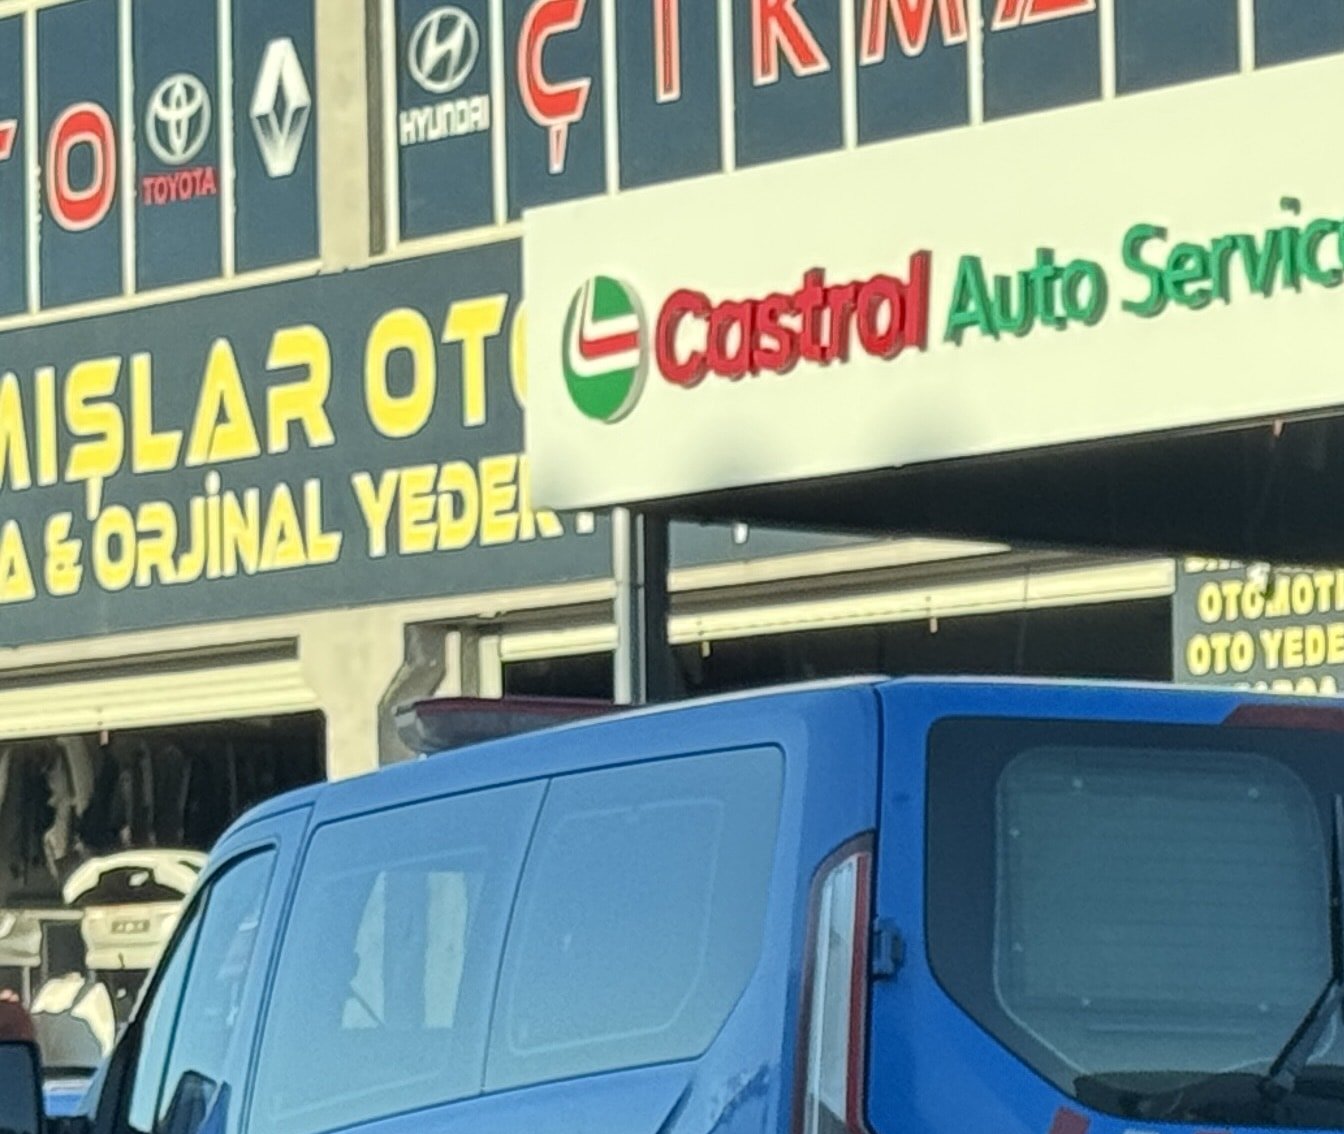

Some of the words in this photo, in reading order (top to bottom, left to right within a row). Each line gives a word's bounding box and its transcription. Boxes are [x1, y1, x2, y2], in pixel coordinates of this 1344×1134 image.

[400, 94, 490, 146] HYUNDAI
[142, 165, 216, 206] TOYOTA
[654, 249, 933, 388] Castrol
[943, 247, 1108, 344] Auto
[364, 292, 525, 440] OT
[43, 510, 83, 596] &
[92, 469, 343, 592] ORJİNAL
[1186, 630, 1255, 676] OTO
